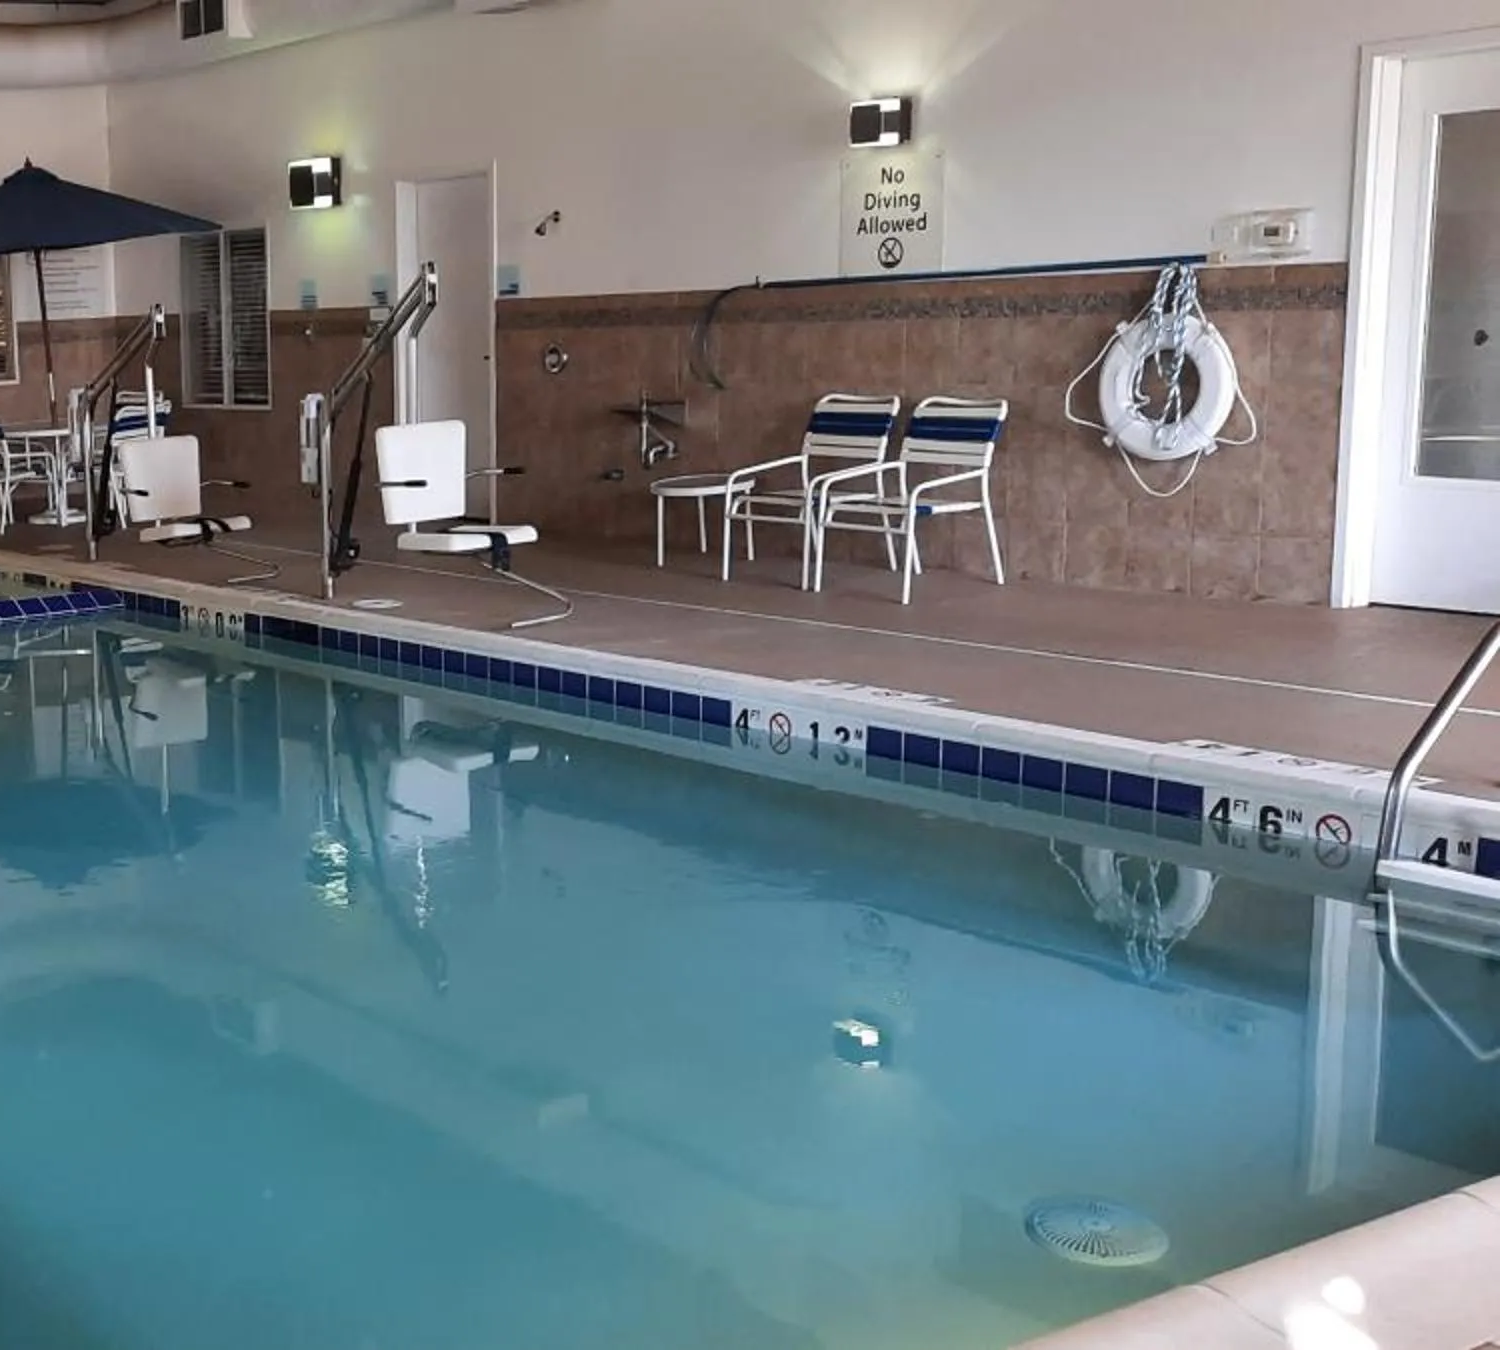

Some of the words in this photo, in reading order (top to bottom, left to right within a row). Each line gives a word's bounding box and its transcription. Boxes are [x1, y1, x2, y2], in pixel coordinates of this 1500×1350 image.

[881, 167, 905, 185] No
[864, 190, 921, 213] Diving
[856, 211, 928, 236] Allowed
